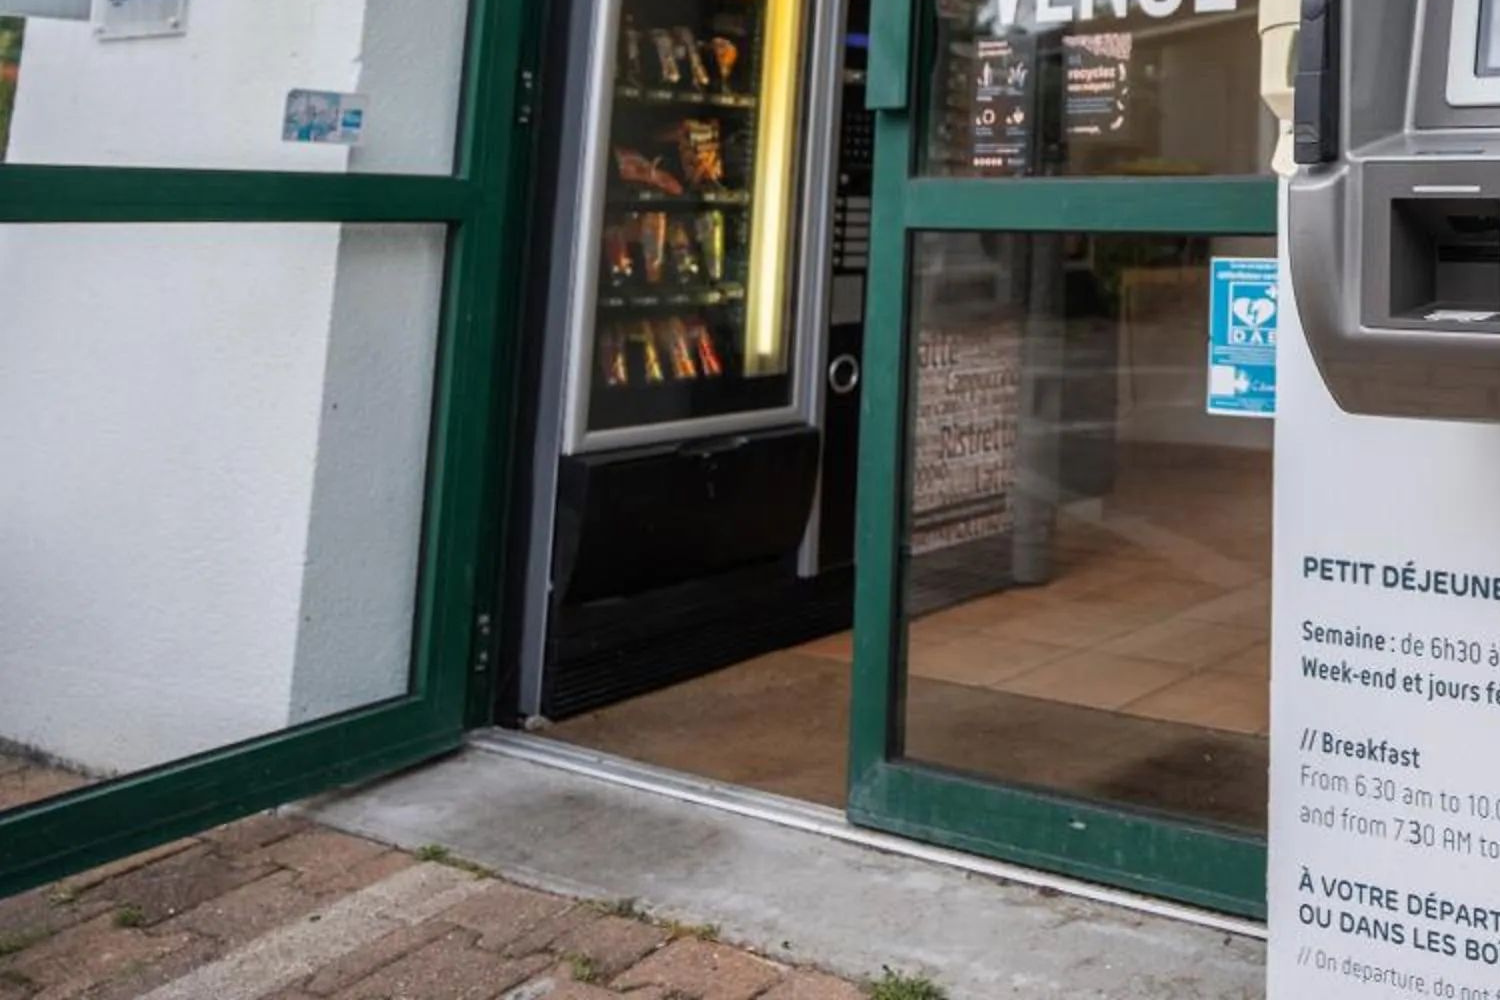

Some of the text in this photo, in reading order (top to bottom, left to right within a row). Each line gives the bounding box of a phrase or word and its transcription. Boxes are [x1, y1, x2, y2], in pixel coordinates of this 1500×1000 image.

[1302, 556, 1375, 586] PETIT
[1302, 620, 1386, 651] Semaine
[1400, 635, 1425, 656] de
[1431, 637, 1482, 664] 6h30
[1488, 641, 1499, 666] à
[1301, 656, 1396, 690] Week-end
[1403, 673, 1424, 694] et
[1428, 672, 1480, 701] jours
[1322, 732, 1420, 768] Breakfast
[1301, 766, 1349, 795] From
[1355, 775, 1395, 801] 6.30
[1402, 788, 1433, 809] am
[1440, 791, 1460, 813] to
[1300, 805, 1334, 828] and
[1342, 808, 1387, 839] from
[1394, 819, 1434, 846] 7.30
[1443, 828, 1471, 854] AM
[1480, 837, 1499, 859] to
[1299, 867, 1315, 893] À
[1321, 877, 1399, 912] VOTRE
[1299, 903, 1331, 929] OU
[1339, 911, 1404, 945] DANS
[1413, 929, 1457, 957] LES
[1315, 949, 1337, 972] On
[1433, 978, 1455, 999] do
